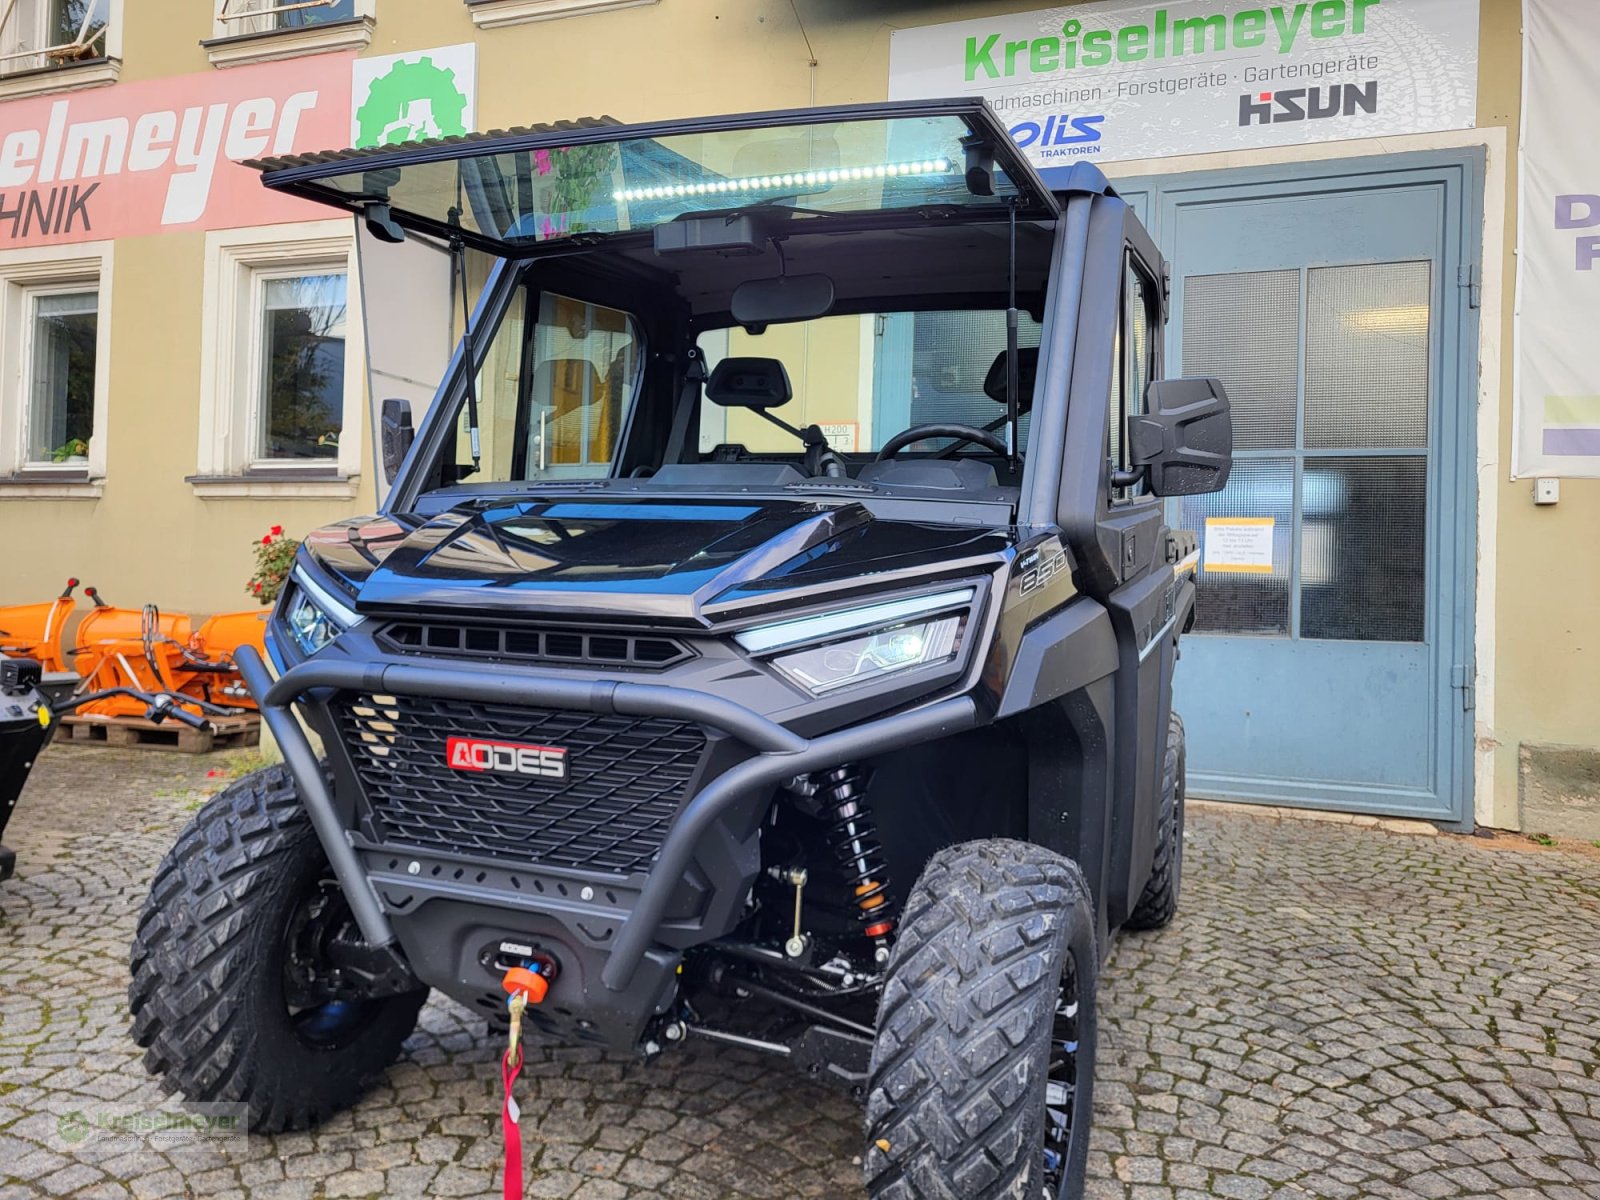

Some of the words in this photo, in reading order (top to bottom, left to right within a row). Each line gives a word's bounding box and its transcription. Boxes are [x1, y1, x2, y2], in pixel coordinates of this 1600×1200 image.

[965, 0, 1380, 81] Kreiselmeyer
[1118, 71, 1227, 97] Forstgeräte
[1244, 56, 1379, 83] Gartengeräte
[1040, 145, 1101, 158] TRAKTOREN
[1019, 547, 1068, 597] 850
[451, 741, 565, 778] AODES
